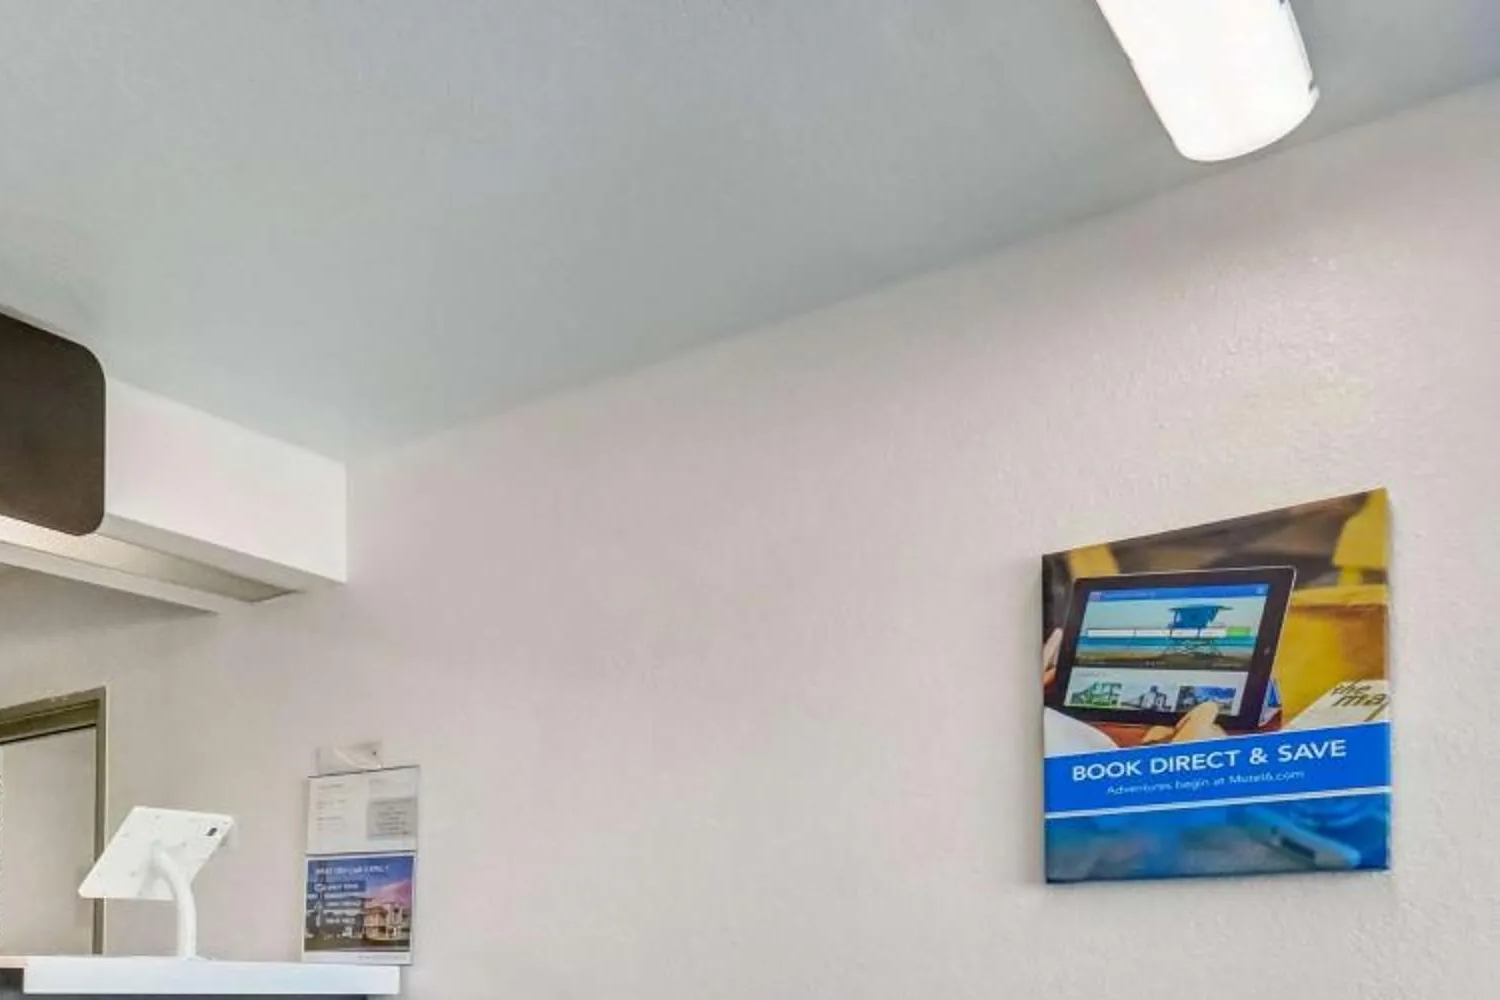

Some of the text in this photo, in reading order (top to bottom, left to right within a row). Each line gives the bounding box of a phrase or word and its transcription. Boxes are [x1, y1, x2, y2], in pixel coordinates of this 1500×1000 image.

[1071, 739, 1347, 782] BOOK DIRECT & SAVE
[1106, 782, 1172, 796] Adventures
[1175, 777, 1210, 793] begin
[1213, 776, 1226, 786] at
